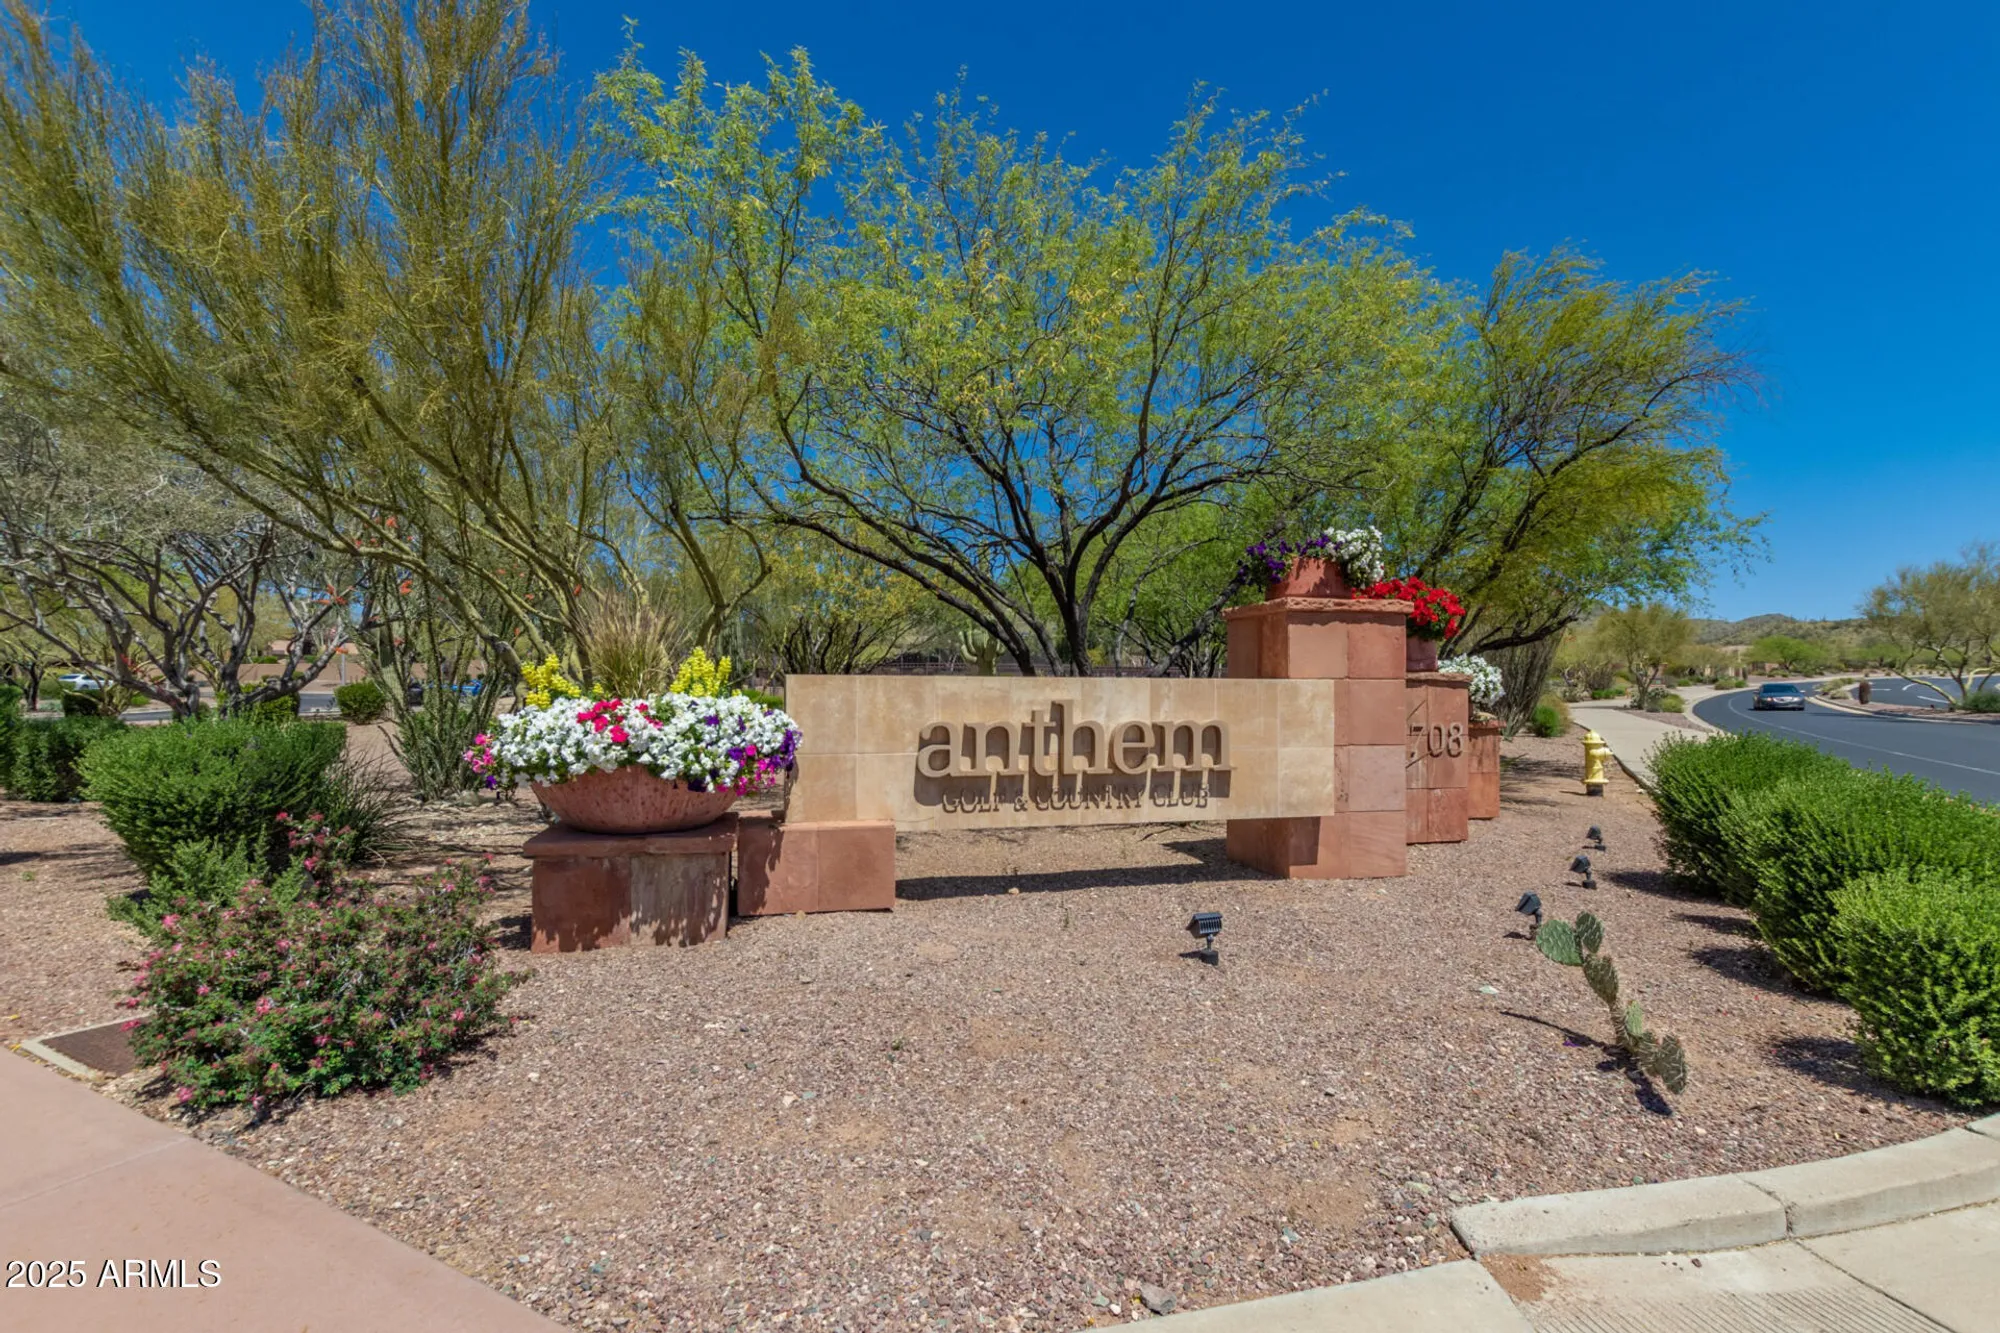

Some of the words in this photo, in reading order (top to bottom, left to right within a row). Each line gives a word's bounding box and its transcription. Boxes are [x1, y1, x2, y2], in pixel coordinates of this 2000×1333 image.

[915, 698, 1236, 779] anthem
[943, 788, 1005, 812] GOLF
[1014, 790, 1028, 812] &
[1035, 785, 1146, 811] COUNTRY
[1152, 784, 1210, 808] CLUB
